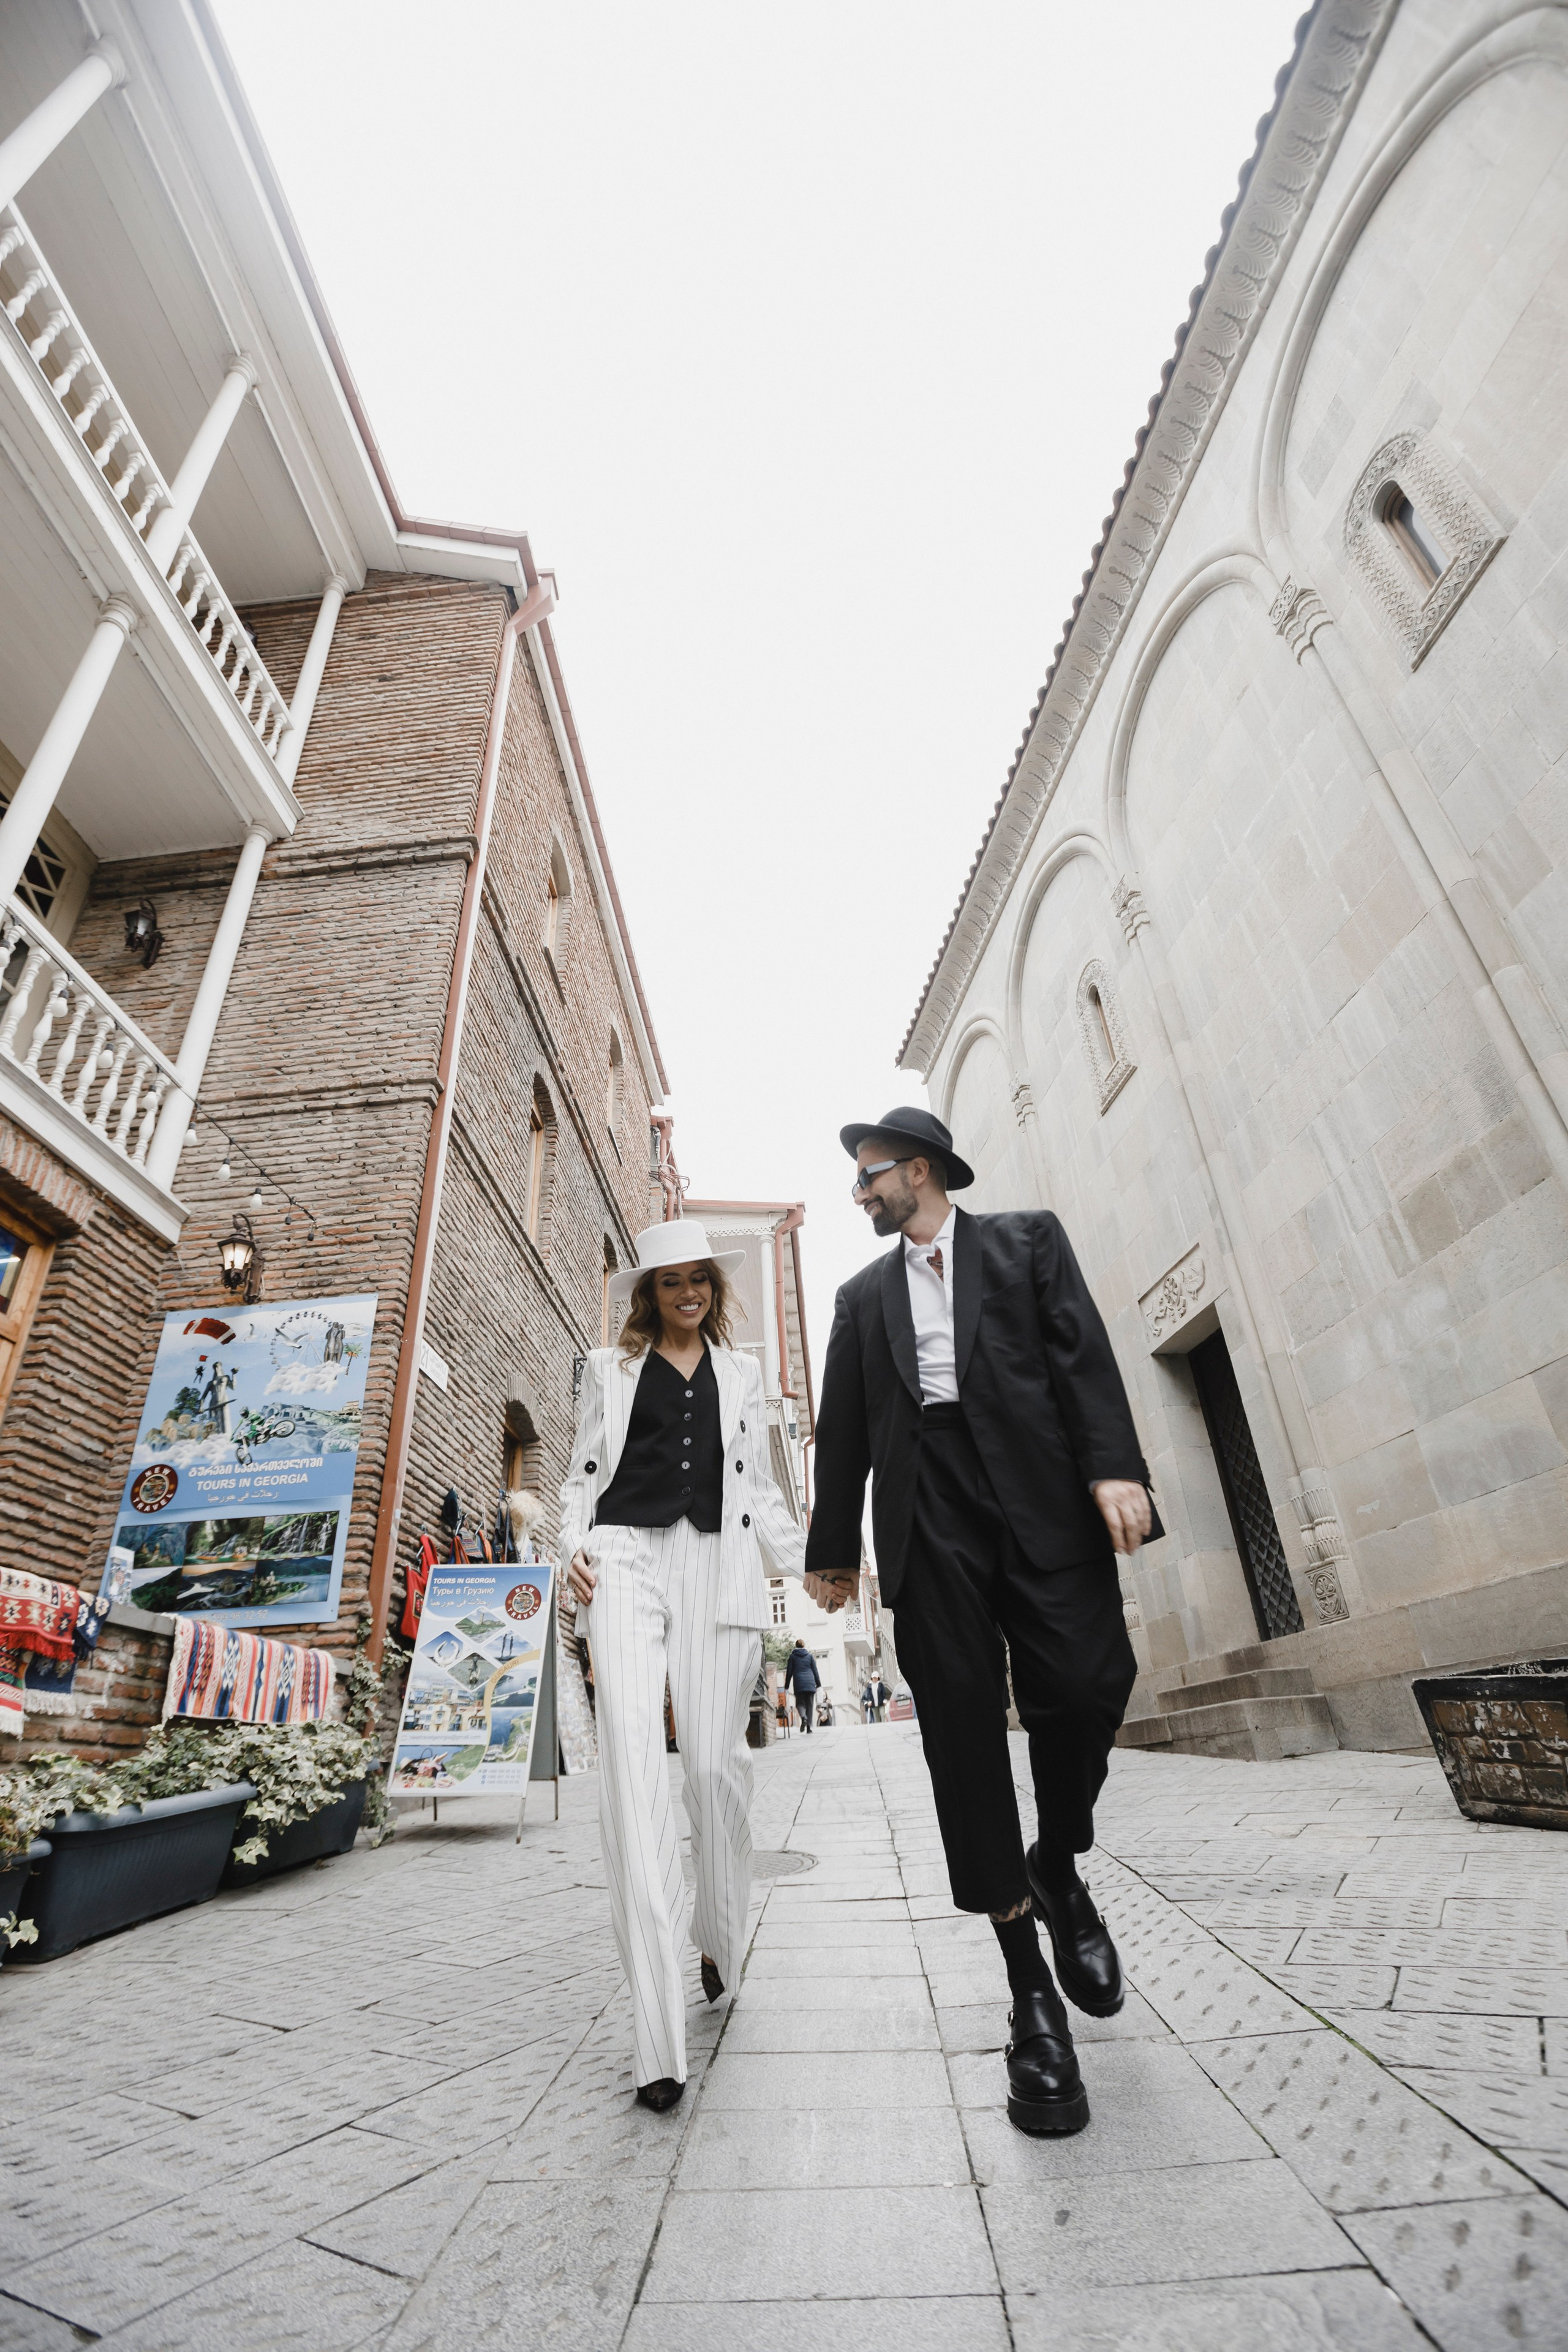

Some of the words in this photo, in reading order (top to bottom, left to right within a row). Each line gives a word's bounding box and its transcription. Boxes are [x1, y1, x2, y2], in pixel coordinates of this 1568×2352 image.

[145, 1466, 172, 1477] NEW
[197, 1478, 236, 1491] TOURS
[239, 1477, 251, 1488] IN
[254, 1473, 309, 1487] GEORGIA
[133, 1493, 174, 1512] TRAVEL
[432, 1587, 453, 1596] Туры
[463, 1587, 494, 1597] Грузию
[507, 1605, 538, 1619] TRAVEL
[491, 1659, 519, 1683] GUDAURI
